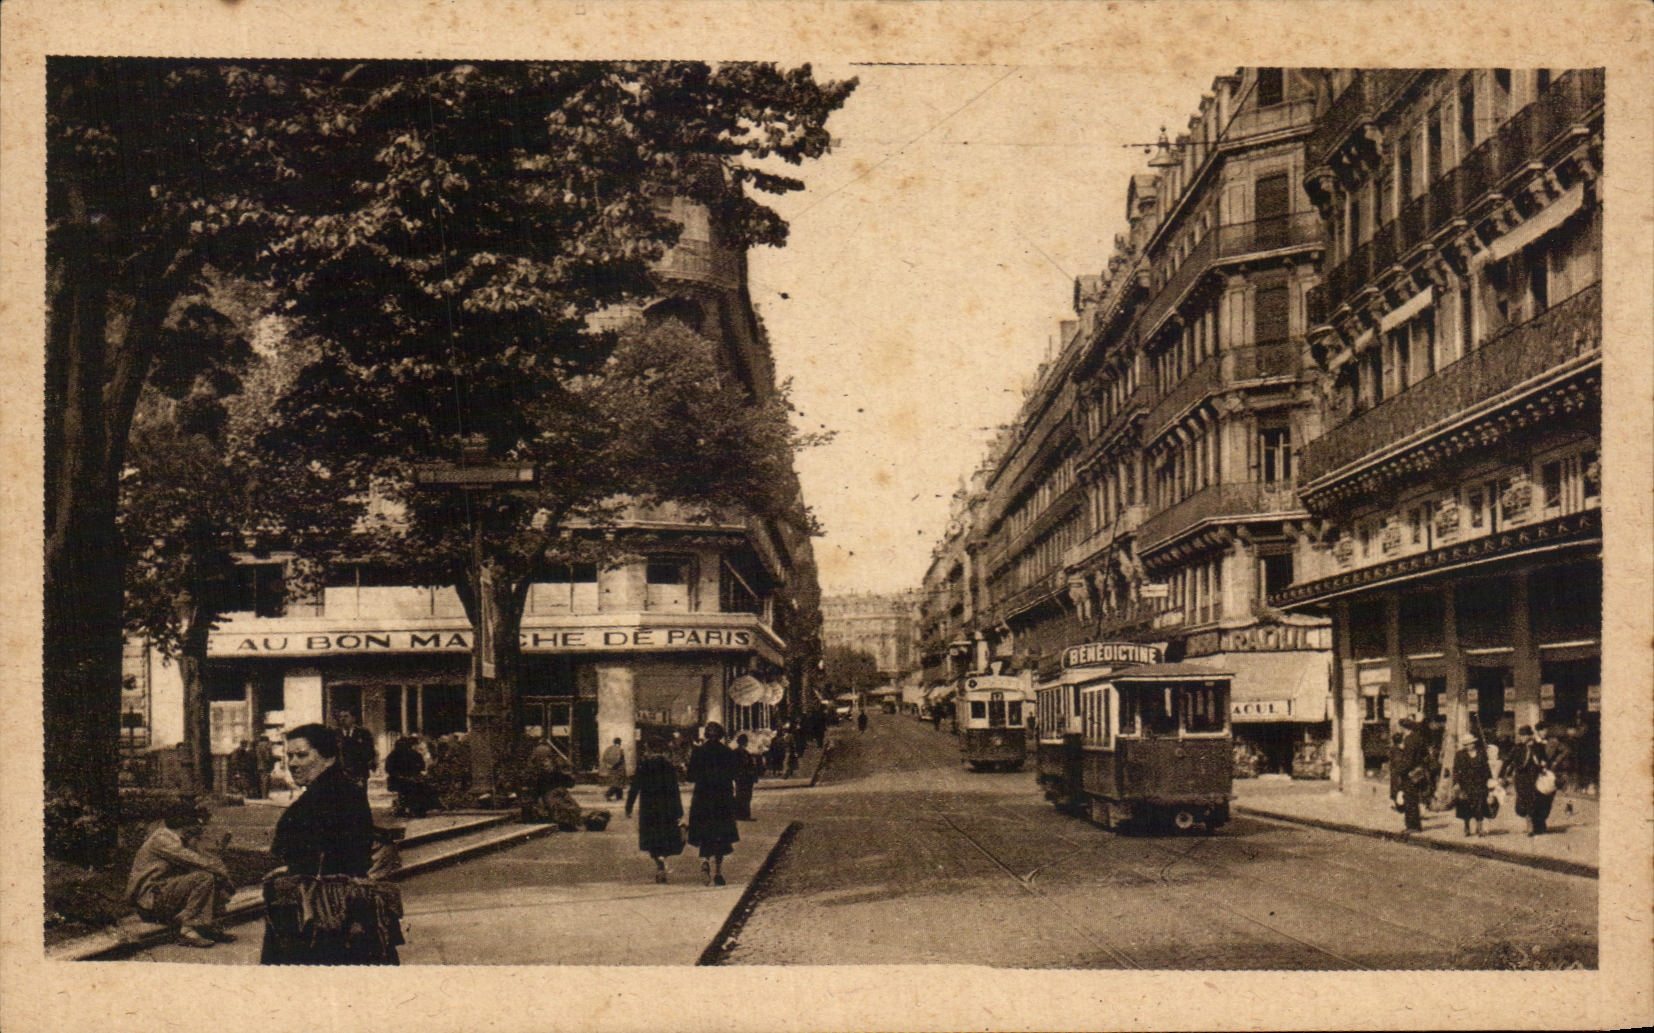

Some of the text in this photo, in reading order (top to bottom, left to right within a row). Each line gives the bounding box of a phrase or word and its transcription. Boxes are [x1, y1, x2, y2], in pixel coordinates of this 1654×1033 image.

[237, 629, 750, 651] AU BON MAHE DE PARIS
[1230, 625, 1313, 650] RAOUL
[1231, 703, 1280, 715] AOUL
